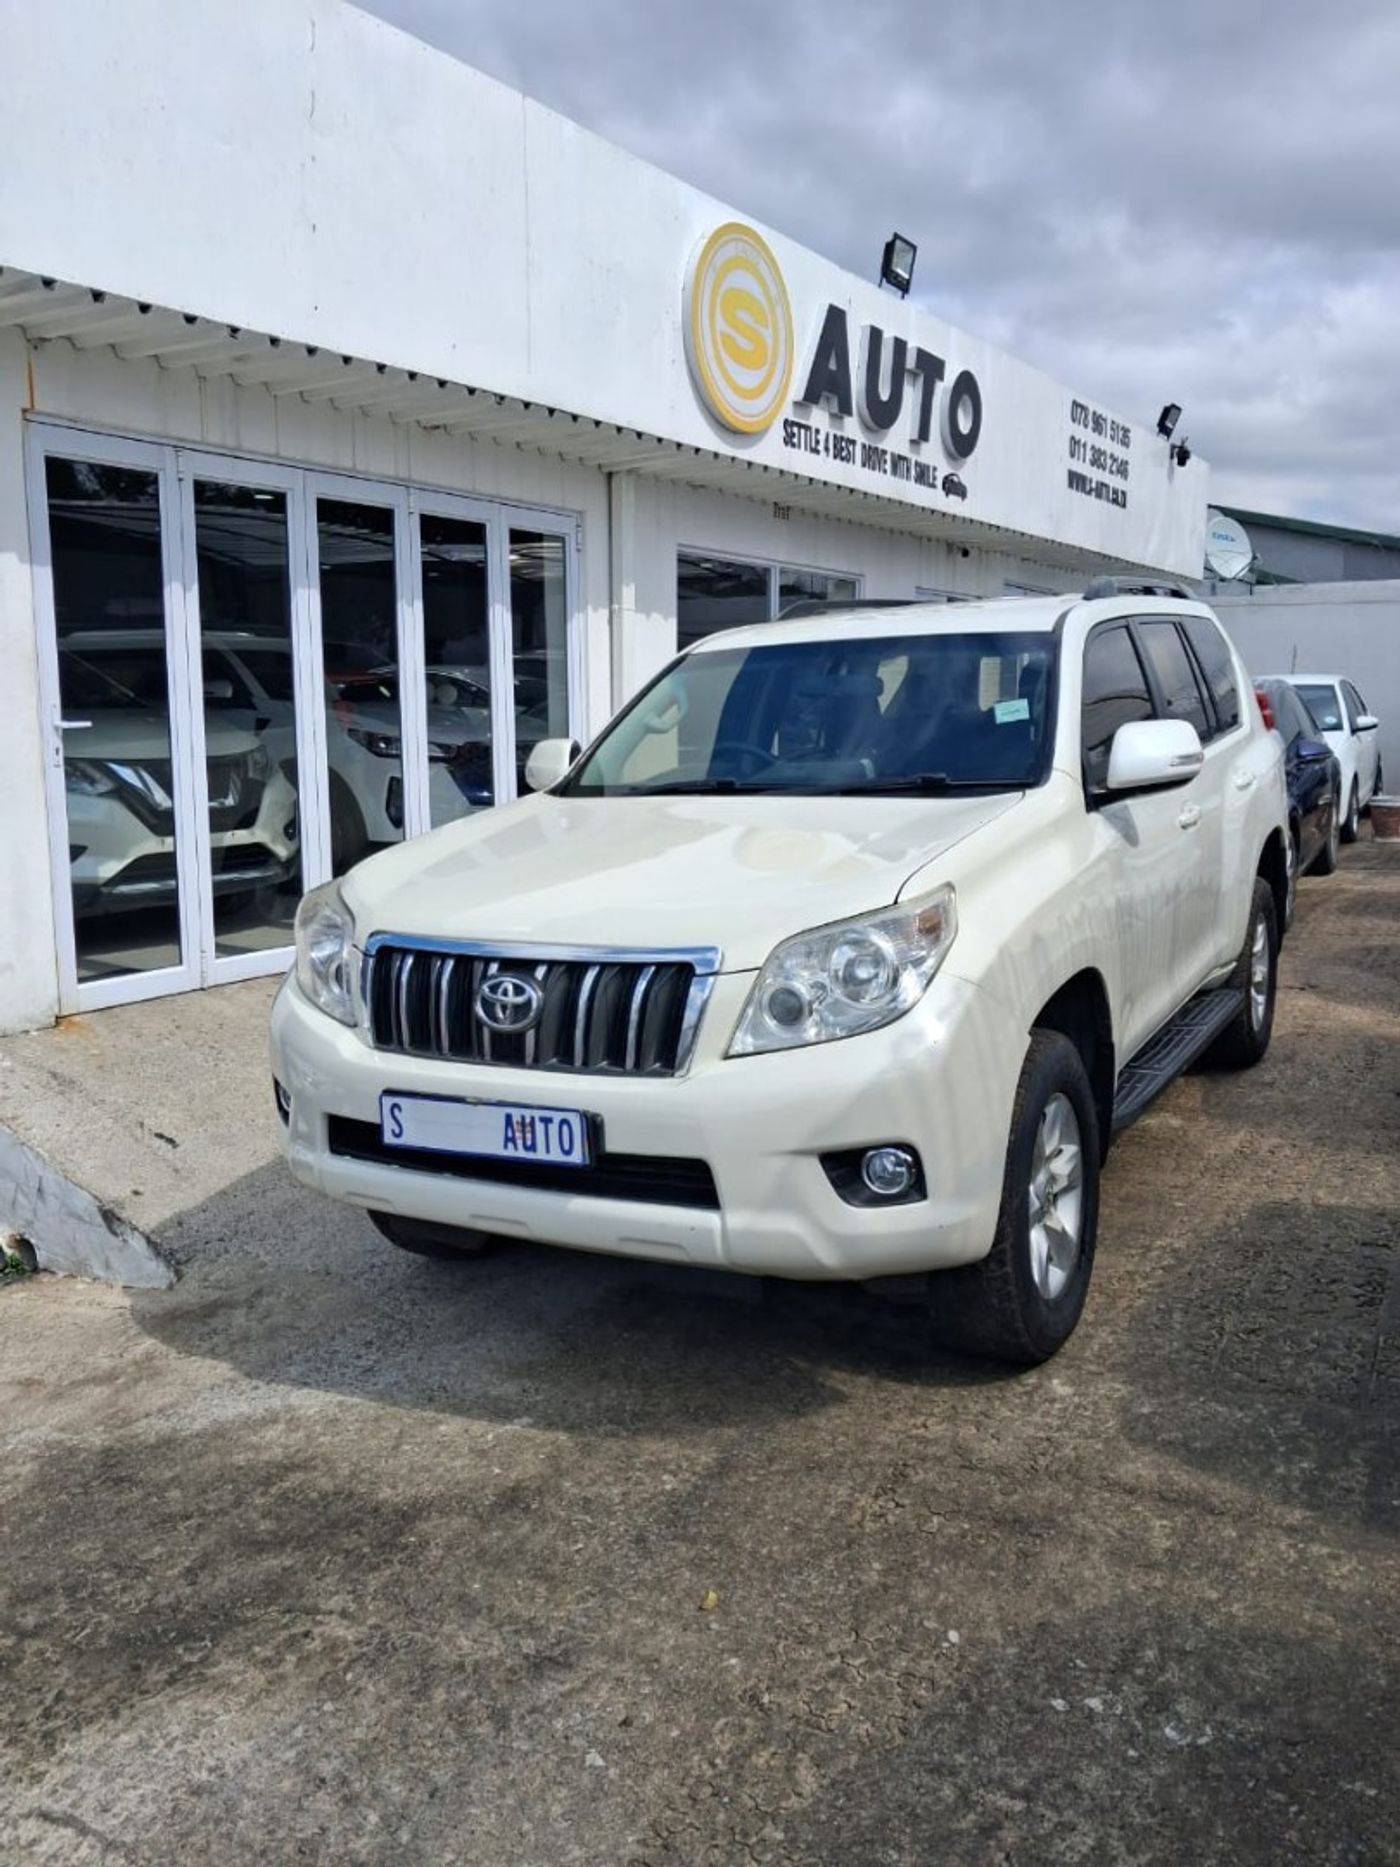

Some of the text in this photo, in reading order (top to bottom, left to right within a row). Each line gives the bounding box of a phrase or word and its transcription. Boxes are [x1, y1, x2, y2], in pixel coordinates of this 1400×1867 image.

[719, 288, 982, 459] S AUTO
[783, 418, 938, 489] SETTLE 4 BEST DRIVE WITH SMILE
[390, 1103, 575, 1156] S AUTO
